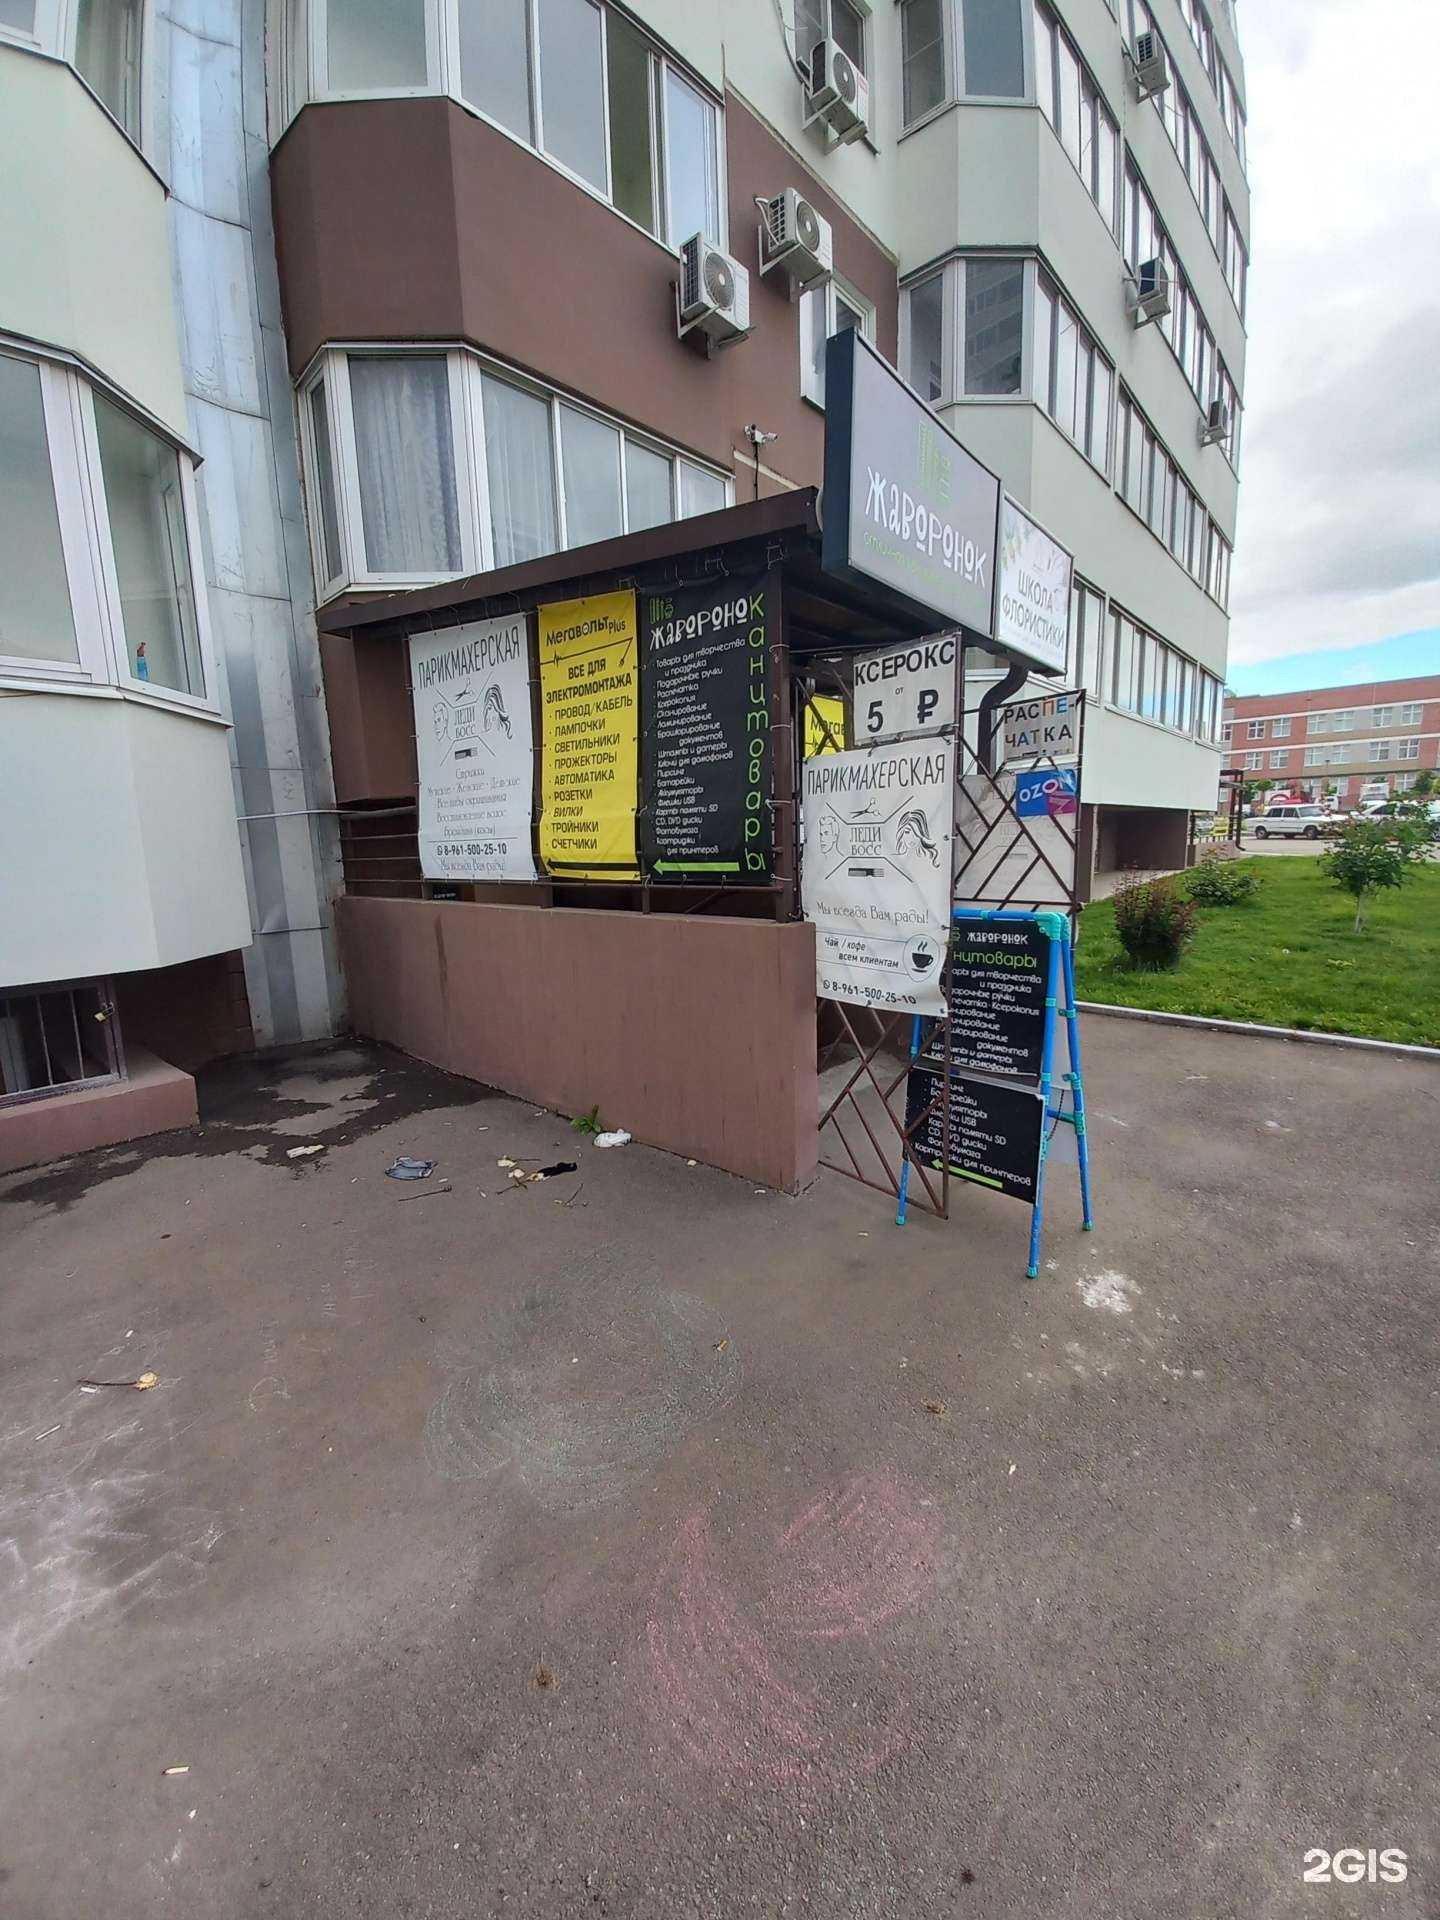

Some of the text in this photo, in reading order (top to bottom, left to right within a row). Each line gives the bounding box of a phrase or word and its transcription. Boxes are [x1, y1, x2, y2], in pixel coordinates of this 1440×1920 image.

[1018, 569, 1054, 614] ШКОЛА
[1002, 592, 1066, 649] ФЛОРИСТИКИ
[695, 638, 745, 658] творчества
[418, 626, 520, 690] ПАРИКМАХЕРСКАЯ
[854, 640, 956, 687] КСЕРОКС
[568, 658, 606, 680] ВСЕ ДЛЯ
[671, 659, 707, 675] праздника
[546, 673, 632, 704] ЭЛЕКТРОМОНТАЖА
[894, 687, 904, 696] от
[555, 694, 633, 720] ПРОВОД/КАБЕЛЬ
[867, 688, 939, 733] 5 ₽
[555, 718, 606, 737] ЛАМПОЧКИ
[1004, 723, 1073, 748] ЧАТКА
[555, 733, 620, 753] СВЕТИЛЬНИКИ
[555, 752, 617, 769] ПРОЖЕКТОРЫ
[554, 769, 615, 785] АВТОМАТИКА
[808, 753, 946, 796] ПАРИКМАХЕРСКАЯ
[554, 789, 593, 802] РОЗЕТКИ
[683, 796, 696, 805] USB
[553, 806, 583, 818] ВИЛКИ
[551, 820, 599, 833] ТРОЙНИКИ
[850, 826, 881, 843] ЛЕДИ
[444, 842, 507, 856] 8-961-500-25-10
[551, 838, 598, 849] СЧЕТЧИКИ
[851, 844, 881, 856] БОСС
[816, 901, 832, 915] Мы
[870, 905, 891, 922] Вам
[894, 909, 929, 925] рады!
[825, 936, 839, 947] Чай
[847, 942, 866, 952] кофе
[838, 952, 899, 969] всем клиентам
[986, 970, 1042, 984] творчества
[832, 981, 917, 1005] 8-961-500-25-10
[986, 981, 1032, 994] праздника
[961, 1114, 977, 1127] USB
[994, 1134, 1007, 1146] SD
[979, 1163, 1032, 1186] принтеров
